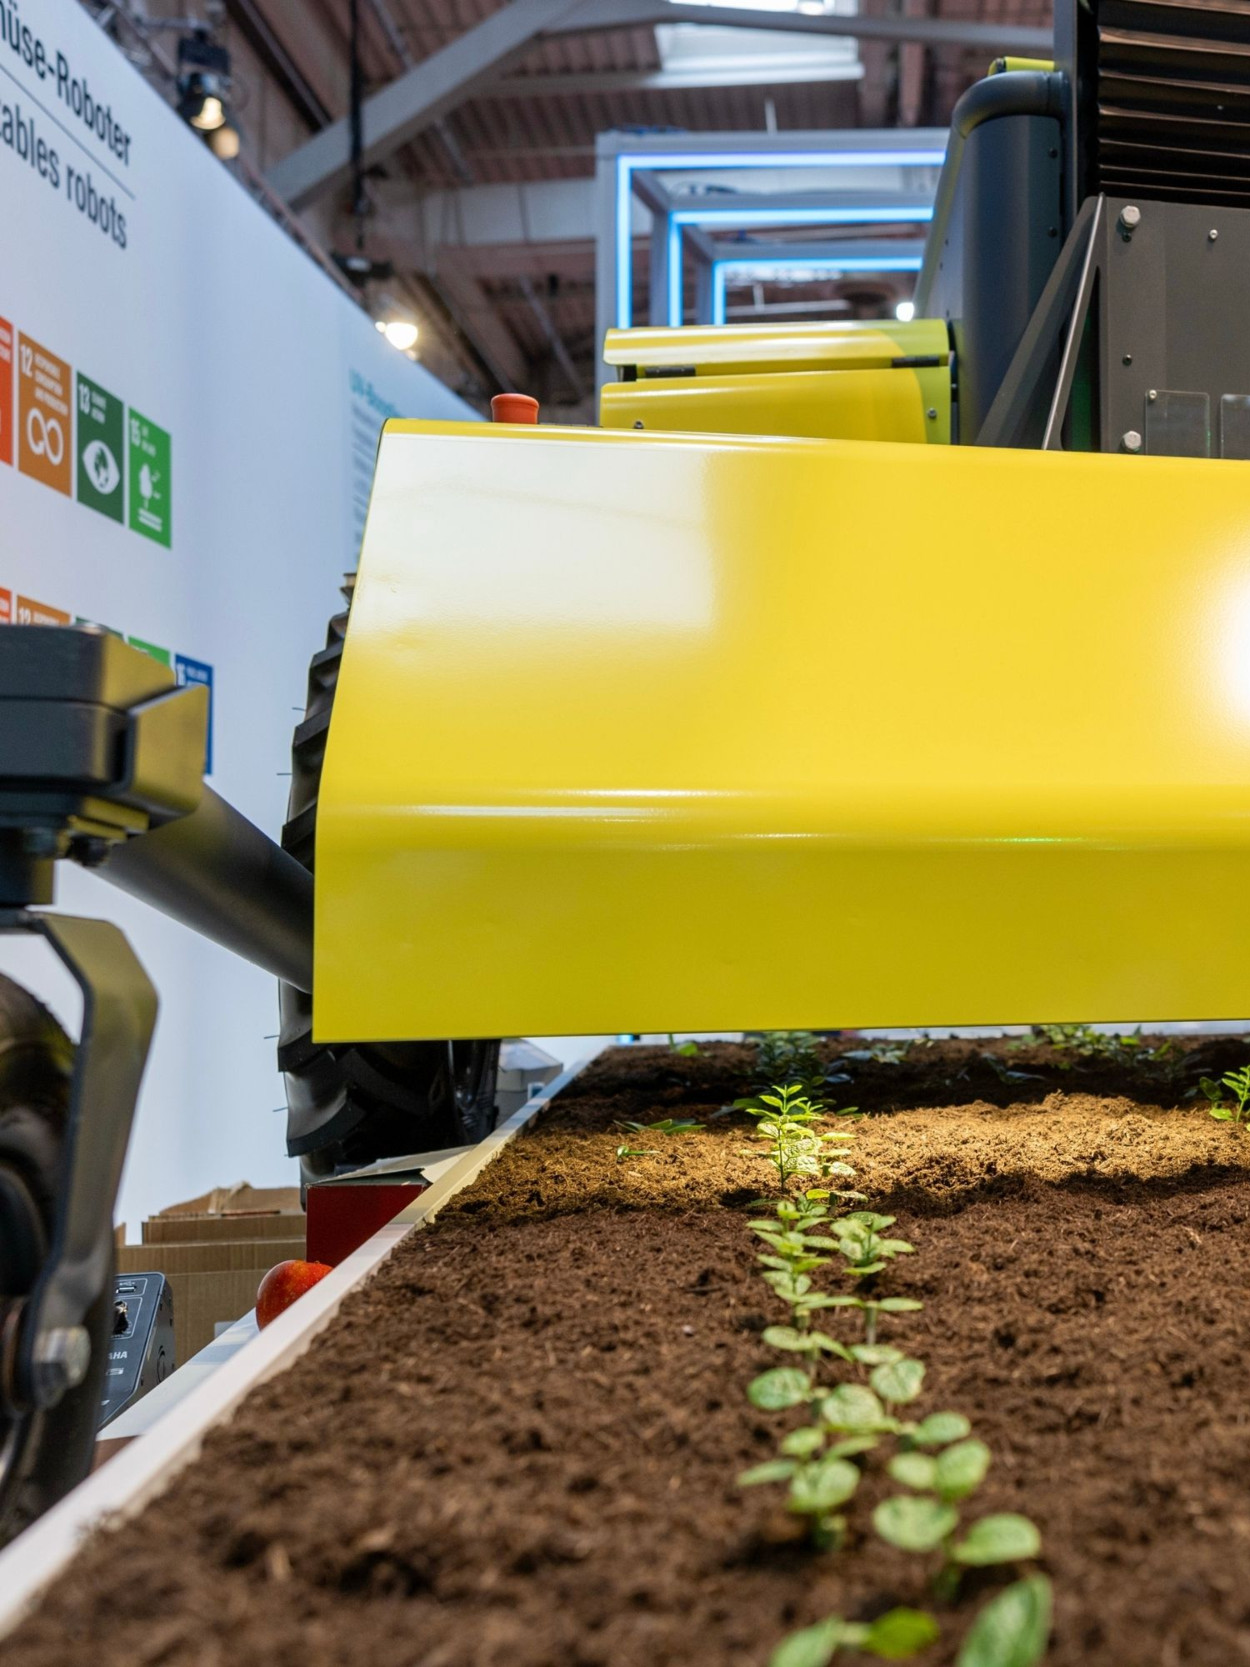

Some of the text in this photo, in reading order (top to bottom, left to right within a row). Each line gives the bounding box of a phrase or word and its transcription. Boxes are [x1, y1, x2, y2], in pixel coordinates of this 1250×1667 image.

[0, 103, 127, 250] ables robots
[20, 343, 33, 378] 12
